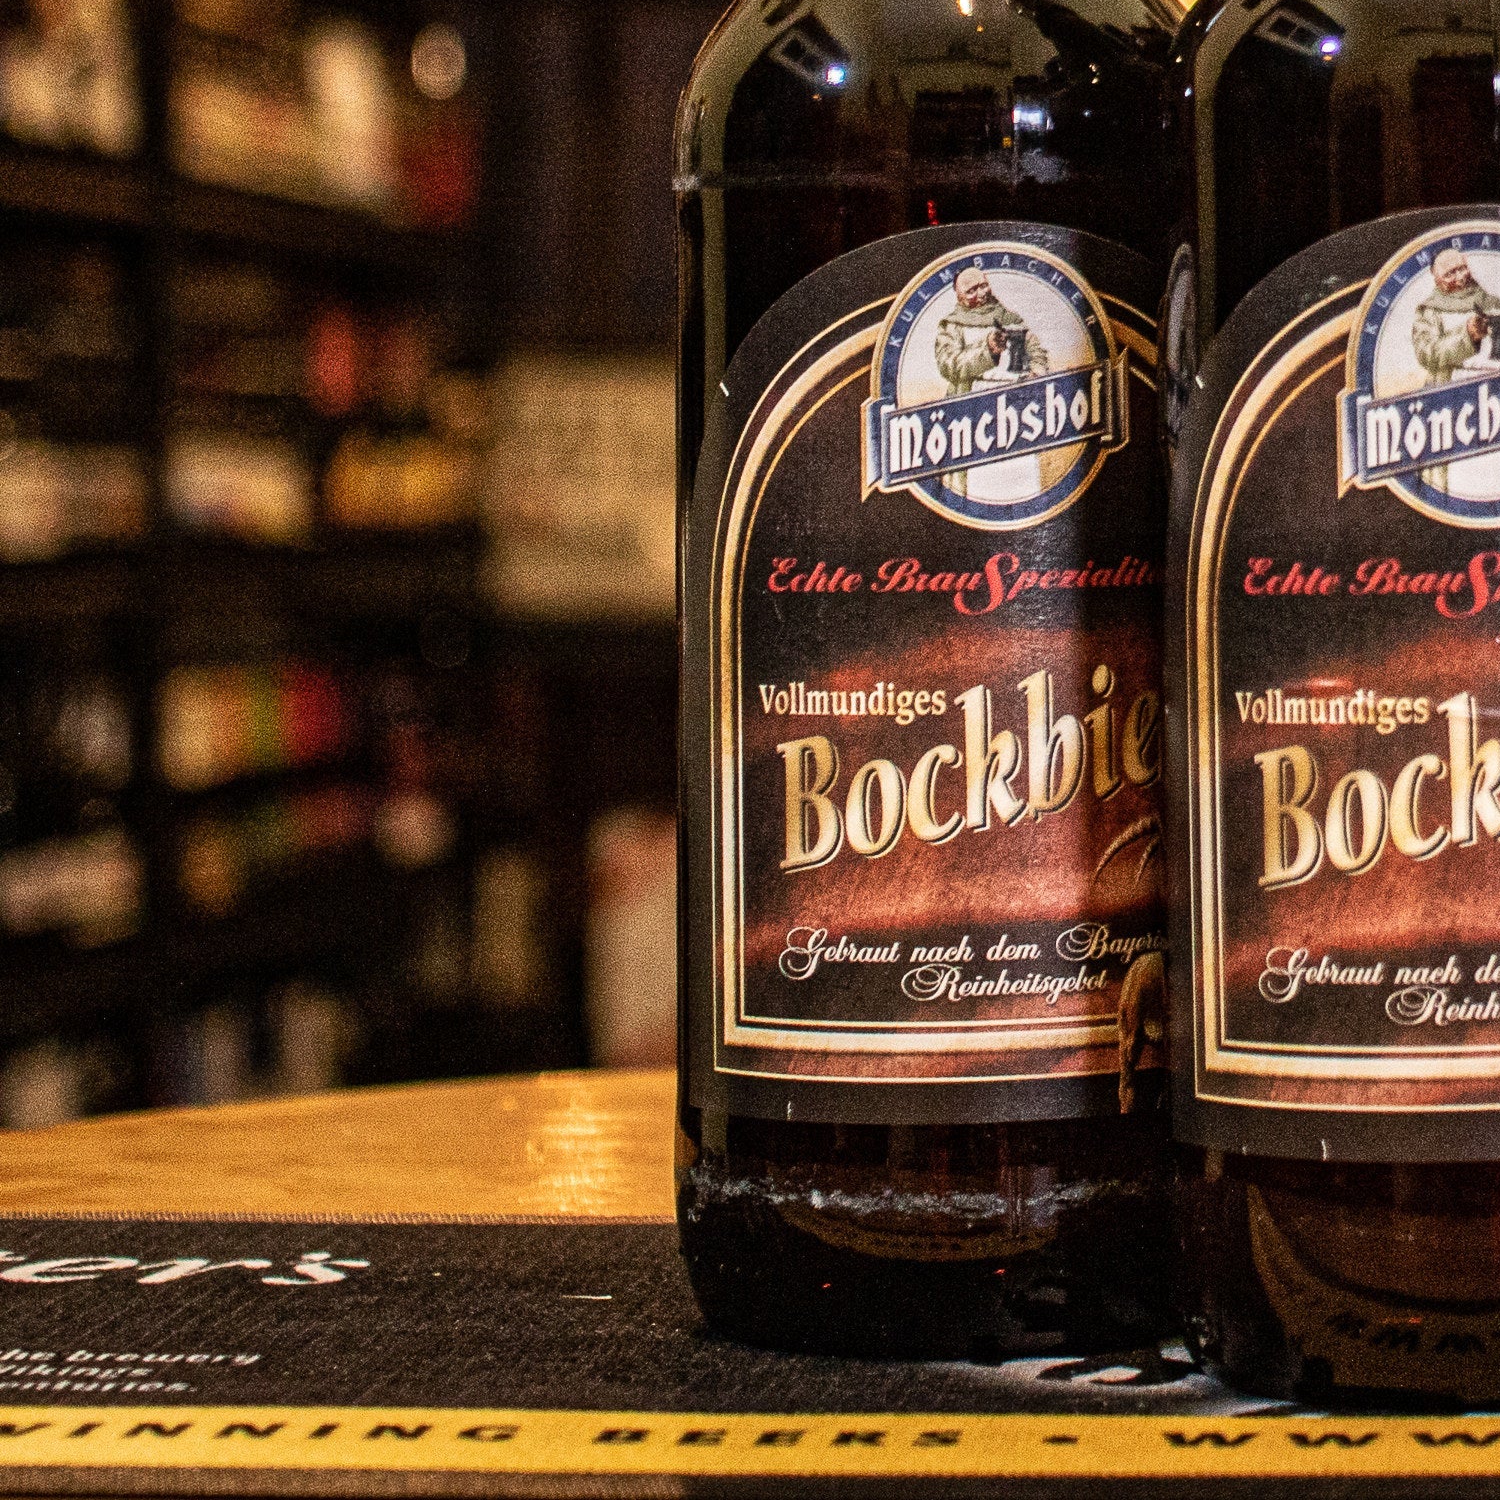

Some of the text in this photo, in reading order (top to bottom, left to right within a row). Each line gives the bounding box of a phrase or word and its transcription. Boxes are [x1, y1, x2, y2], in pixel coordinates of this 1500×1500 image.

[889, 254, 1096, 348] KULMBACHER
[889, 368, 1103, 474] Mönchshof
[767, 552, 1154, 616] Echte BrauSpezialit
[1243, 557, 1342, 597] Echte
[758, 681, 947, 726] Vollmundiges
[1235, 689, 1430, 735] Vollmundiges
[776, 663, 1164, 874] Bockbie
[778, 922, 1164, 981] Gebraut nach dem Bayeri
[901, 963, 1108, 1004] Reinheitsgebot
[1258, 945, 1385, 1005] Gebraut
[1394, 954, 1463, 986] nach
[0, 1348, 262, 1366] he brewery
[0, 1380, 198, 1393] enturies.
[593, 1426, 962, 1447] BEERS
